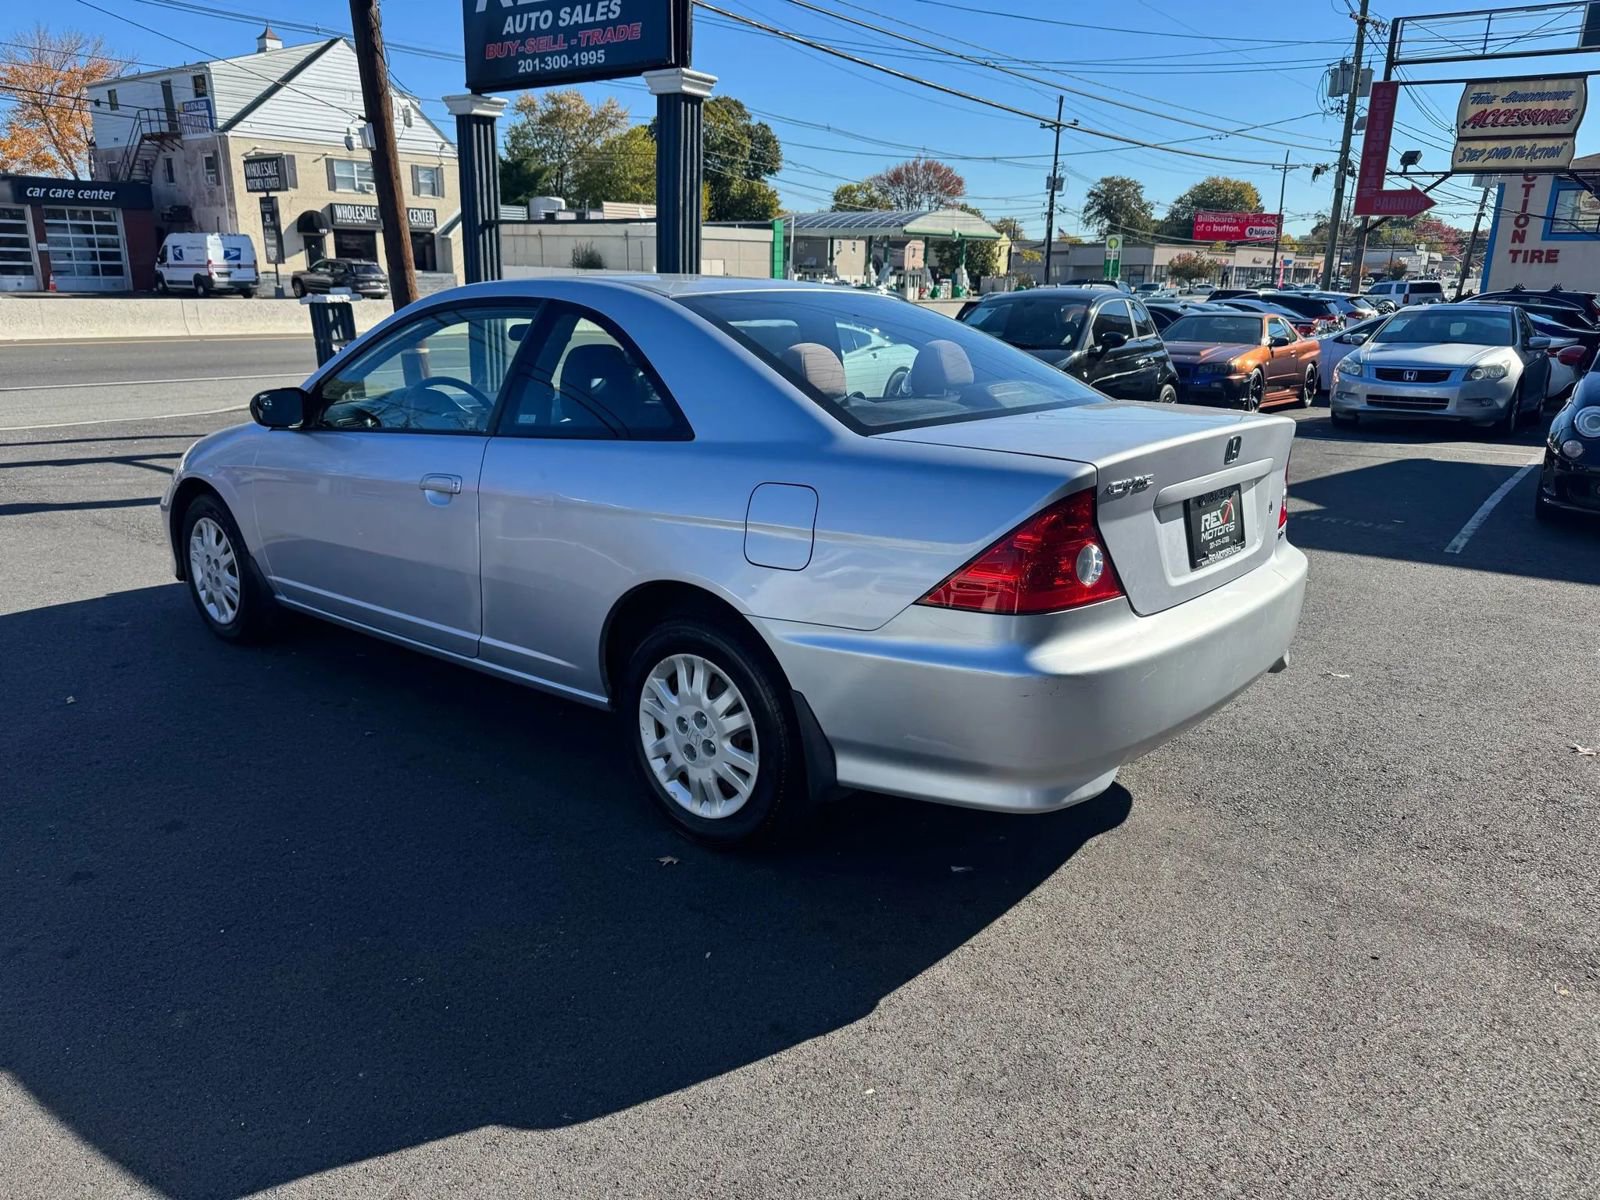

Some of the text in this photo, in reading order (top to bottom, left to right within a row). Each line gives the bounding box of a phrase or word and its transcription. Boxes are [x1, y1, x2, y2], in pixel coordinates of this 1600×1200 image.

[502, 10, 553, 35] AUTO
[558, 0, 622, 27] SALES
[518, 50, 606, 73] 201-300-1995
[1462, 108, 1578, 129] ACCESSORIES
[245, 161, 278, 177] WHOLESALE
[26, 187, 116, 200] car care center
[335, 205, 434, 223] WHOLESALE CENTER
[1197, 214, 1237, 223] Billboards
[1212, 224, 1240, 232] button.
[1254, 228, 1275, 236] blip.co
[1508, 249, 1560, 263] TIRE
[1201, 498, 1234, 532] REV
[1201, 522, 1235, 543] MOTORS
